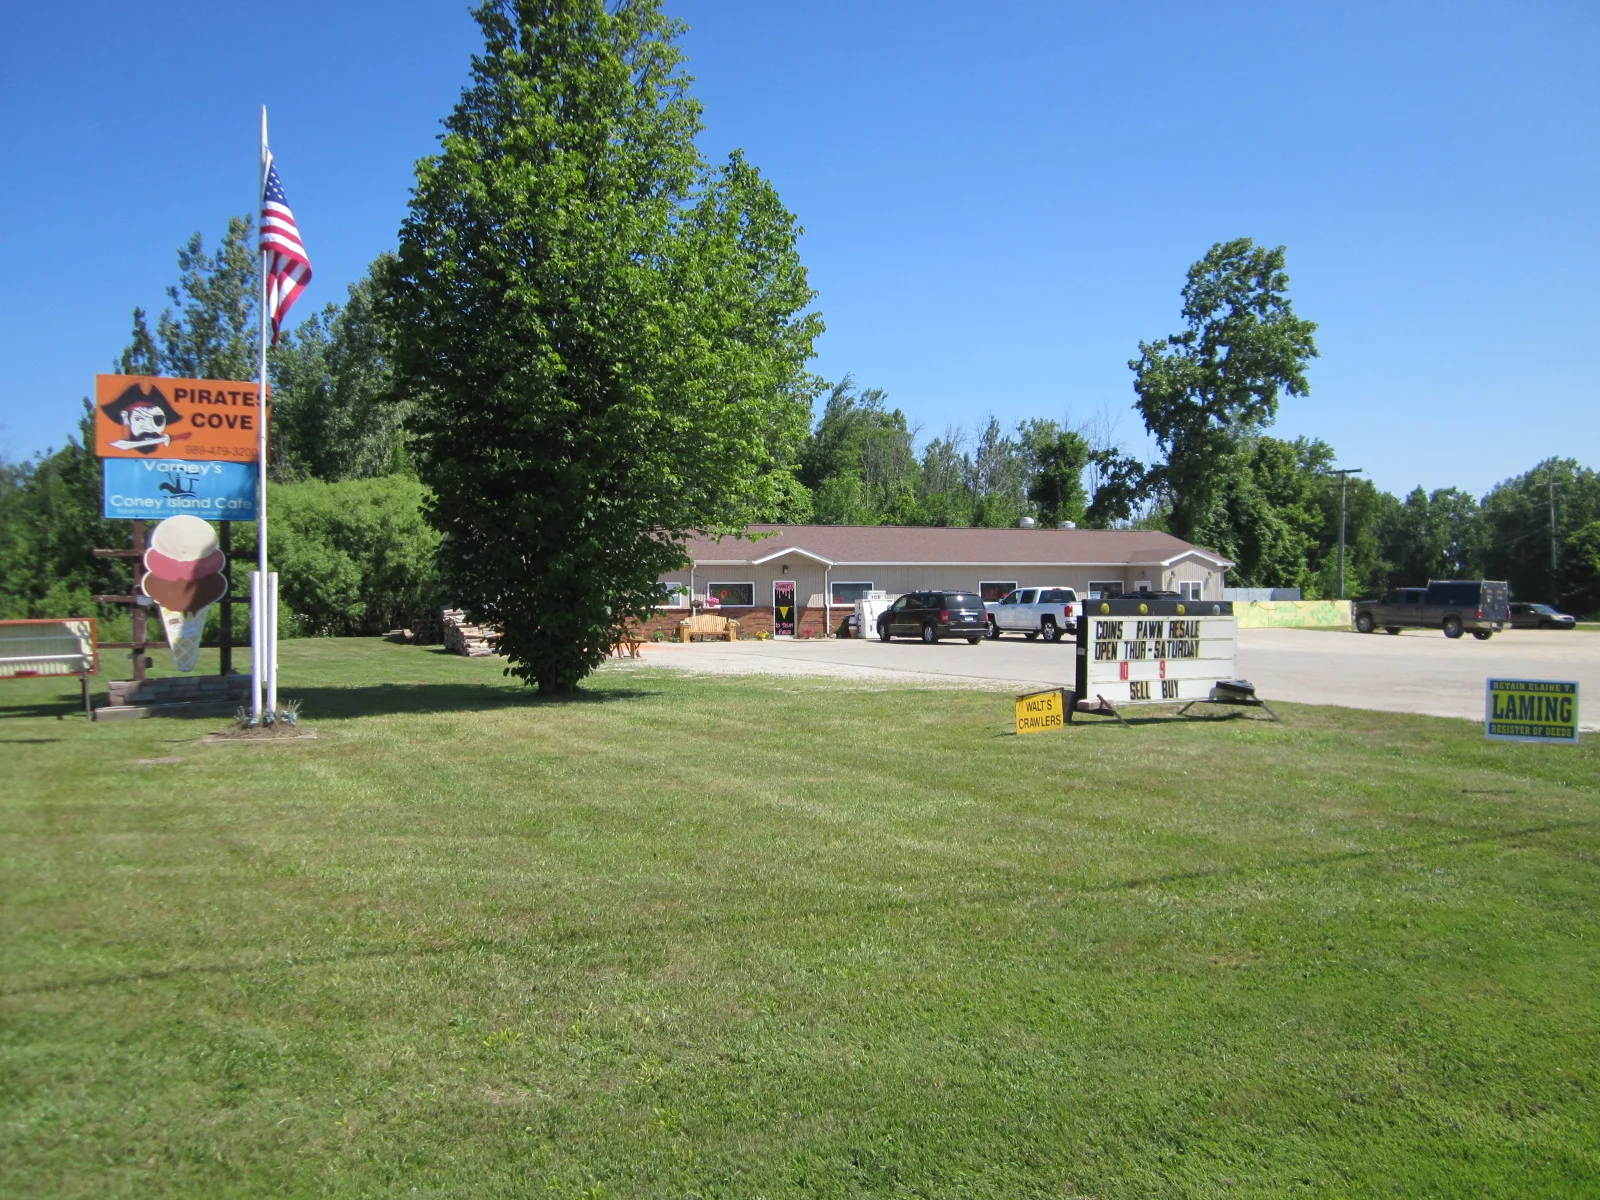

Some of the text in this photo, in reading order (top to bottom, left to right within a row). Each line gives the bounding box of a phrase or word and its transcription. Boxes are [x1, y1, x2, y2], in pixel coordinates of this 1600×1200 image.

[191, 413, 253, 430] COVE
[110, 495, 253, 510] Coney Island Cafe
[1096, 620, 1200, 640] COINS PAWN RESALE
[1095, 641, 1118, 660] OPEN
[1130, 680, 1179, 700] SELL BUY
[1026, 700, 1052, 712] WALT'S
[1492, 694, 1573, 723] LAMING
[1018, 714, 1061, 729] CRAWLERS
[1491, 725, 1572, 737] REGISTER OF DEEDS
